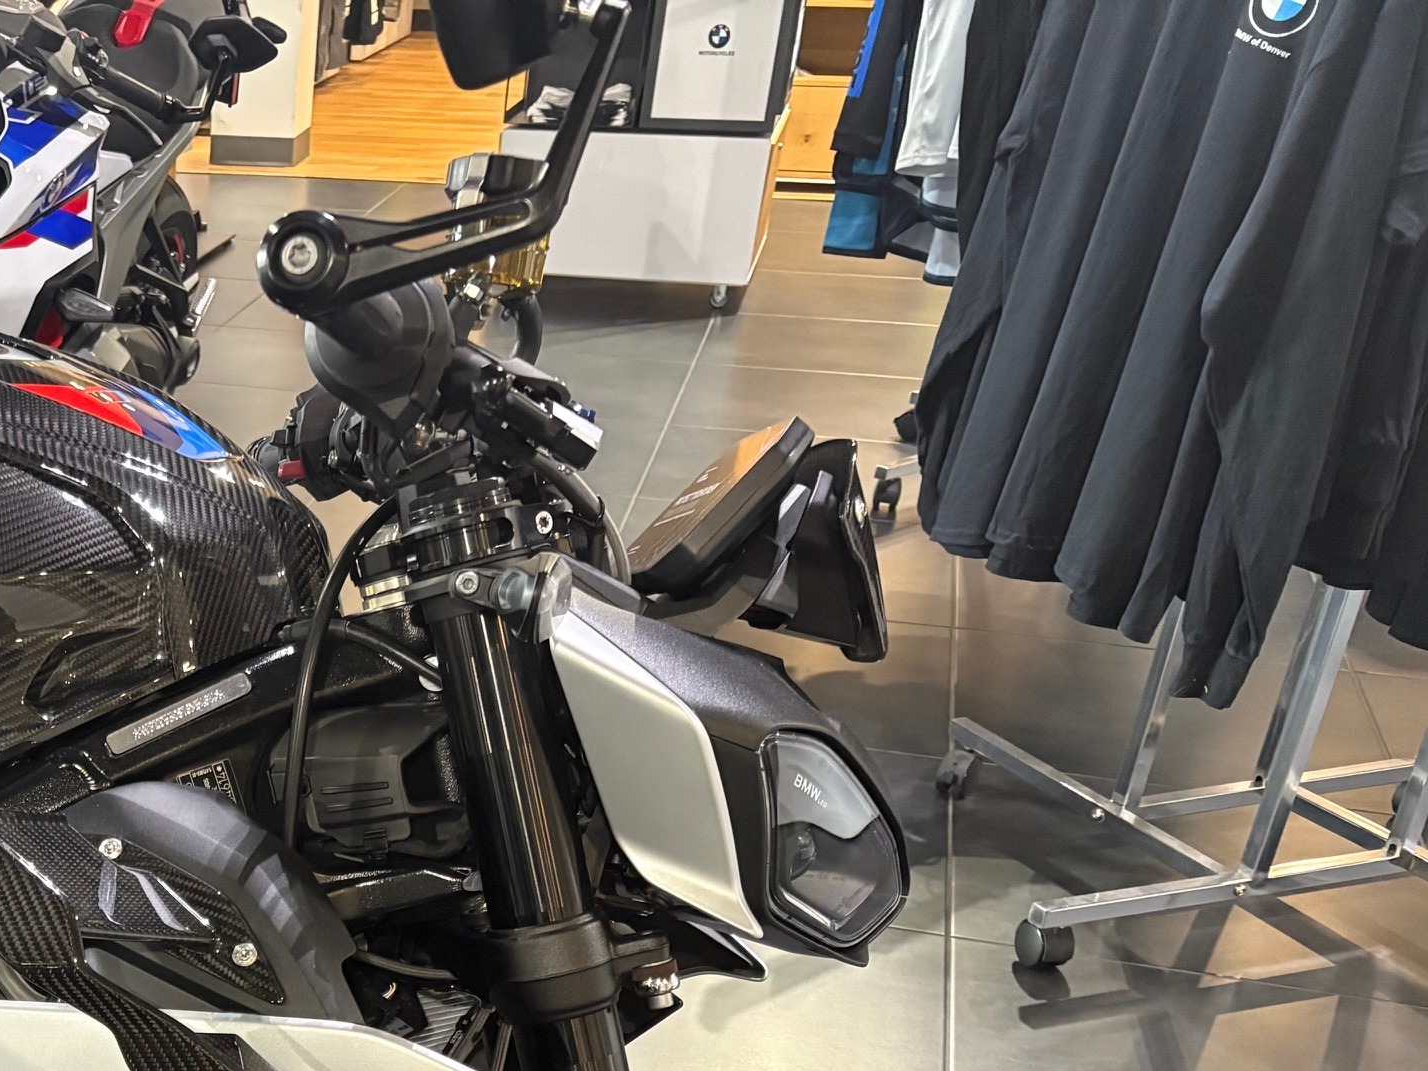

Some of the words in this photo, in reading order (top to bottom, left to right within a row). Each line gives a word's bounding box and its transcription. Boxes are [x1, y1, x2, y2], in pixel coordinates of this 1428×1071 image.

[1250, 38, 1262, 47] of
[1260, 41, 1291, 59] Denver
[793, 773, 823, 802] BMW
[818, 796, 828, 808] LED
